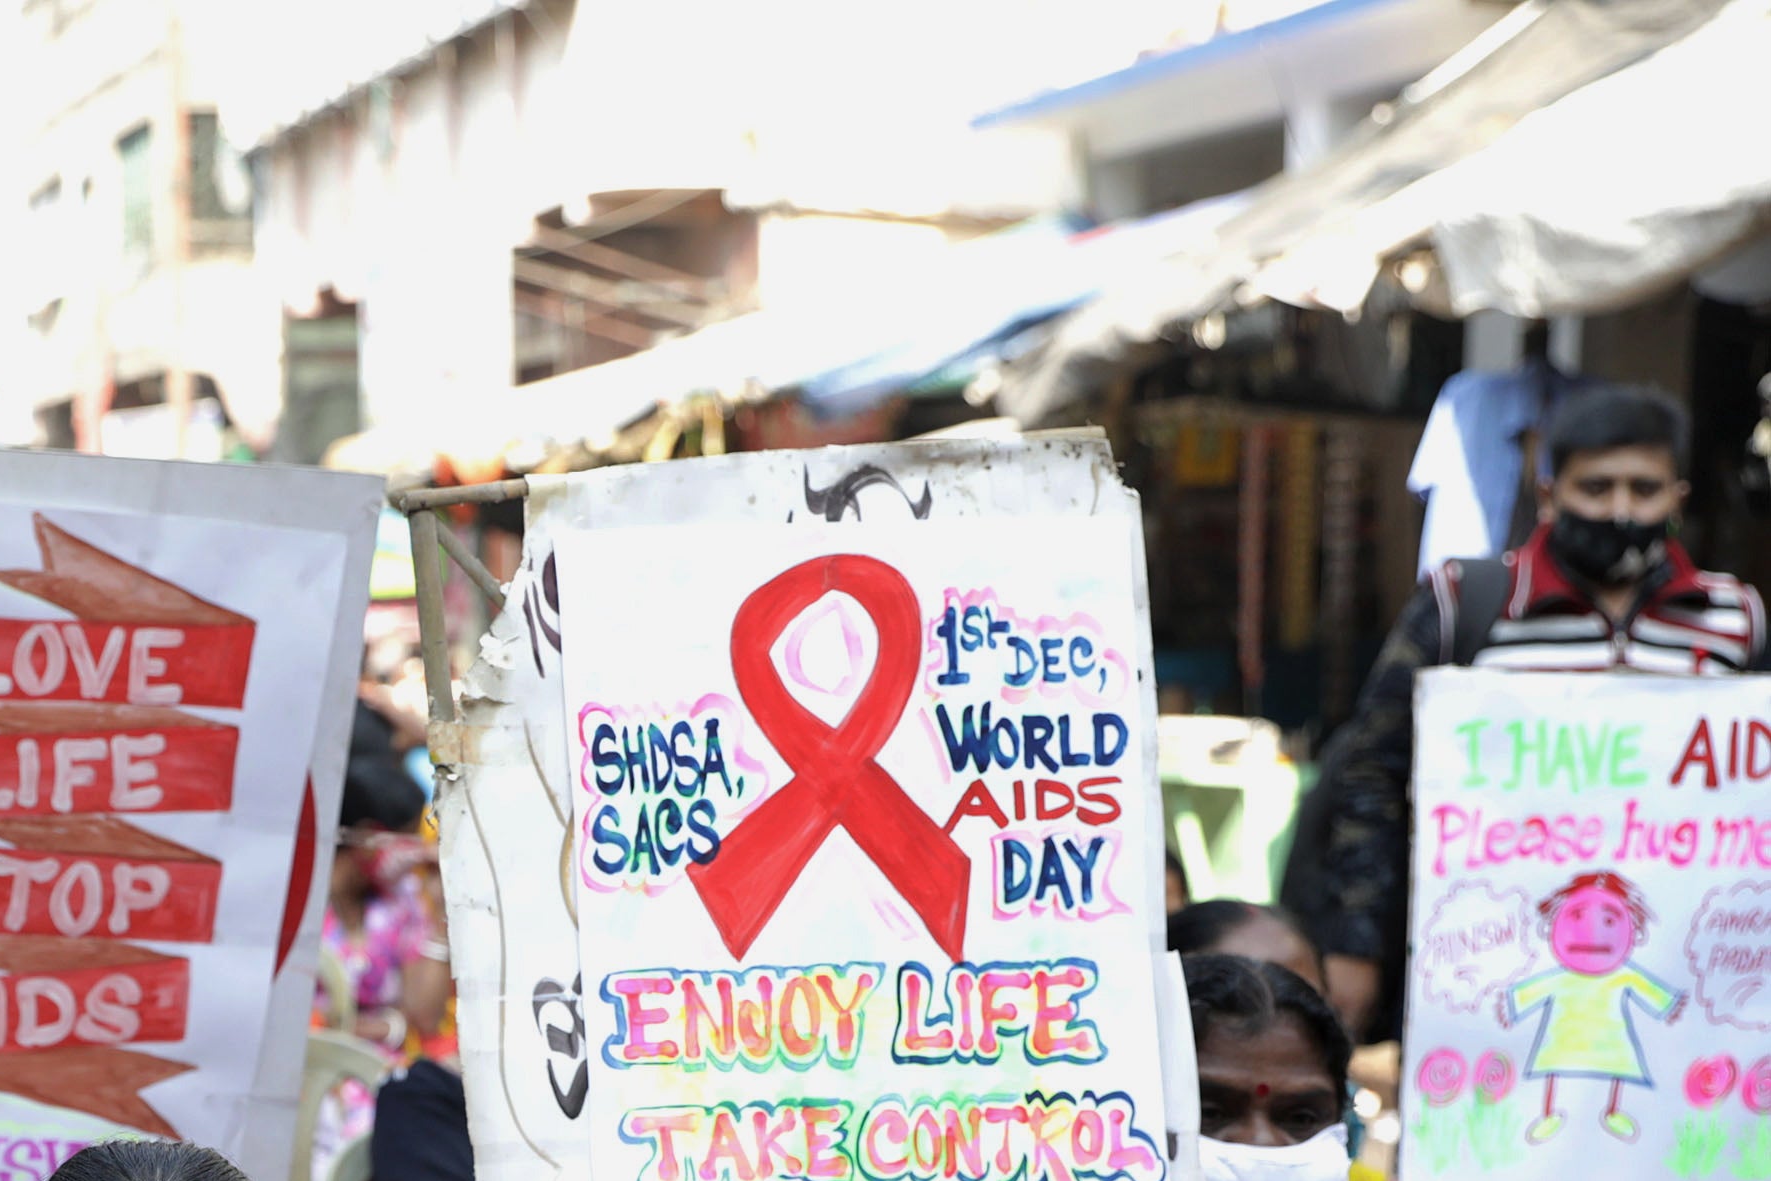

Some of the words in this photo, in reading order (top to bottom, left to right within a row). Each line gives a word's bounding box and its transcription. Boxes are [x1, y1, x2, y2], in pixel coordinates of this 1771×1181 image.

[592, 716, 745, 798] SHDSA,
[938, 700, 1129, 774] WORLD
[1455, 719, 1491, 788] I
[1500, 719, 1649, 794] HAVE
[592, 798, 720, 876] SACS
[943, 776, 1121, 832] AIDS
[1613, 797, 1700, 868] hug
[1003, 836, 1104, 908] DAY
[600, 960, 886, 1072] ENJOY
[890, 958, 1110, 1068] LIFE
